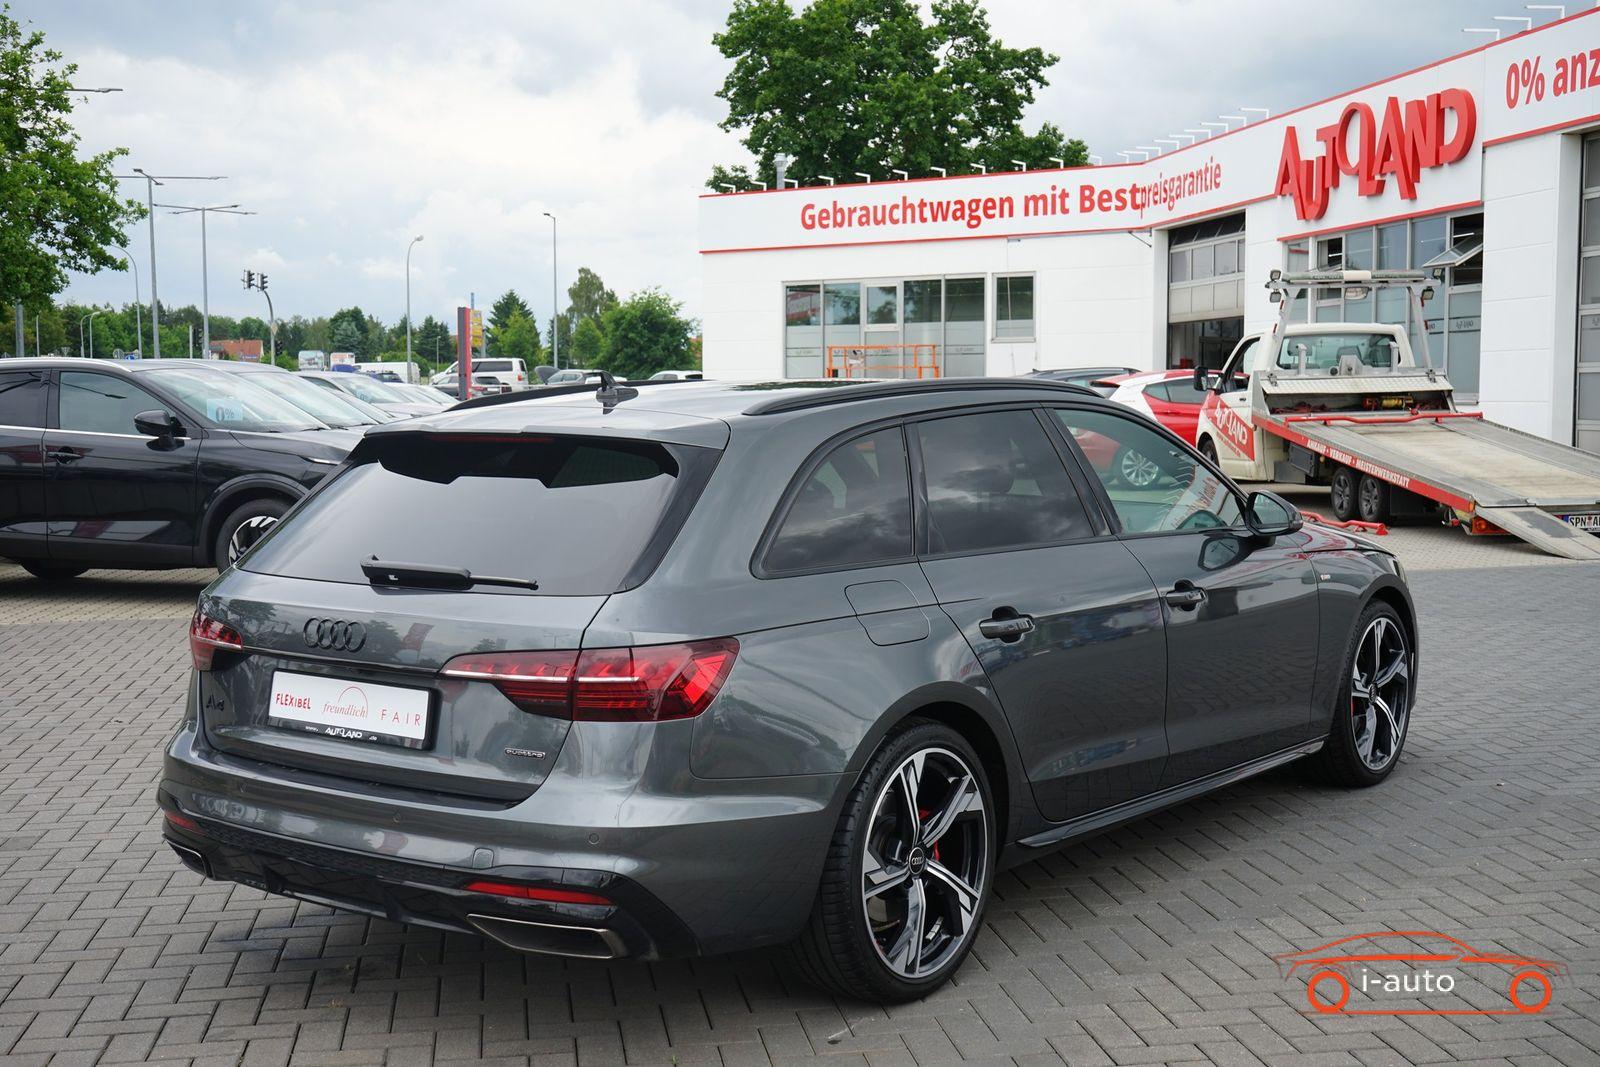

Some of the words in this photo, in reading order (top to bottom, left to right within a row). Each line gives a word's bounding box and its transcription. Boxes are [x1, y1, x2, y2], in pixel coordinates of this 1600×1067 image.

[1506, 55, 1545, 109] 0%
[1553, 48, 1600, 97] anz
[1274, 88, 1477, 221] AUTOLAND
[800, 196, 1014, 230] Gebrauchtwagen
[1024, 185, 1069, 217] mit
[1079, 156, 1221, 219] Bestpreisgarantie
[1569, 516, 1587, 527] SPN
[275, 693, 311, 710] FLEXIBEL
[322, 701, 367, 719] freundlich
[380, 709, 421, 726] FAIR
[325, 727, 363, 740] AUTOLAND
